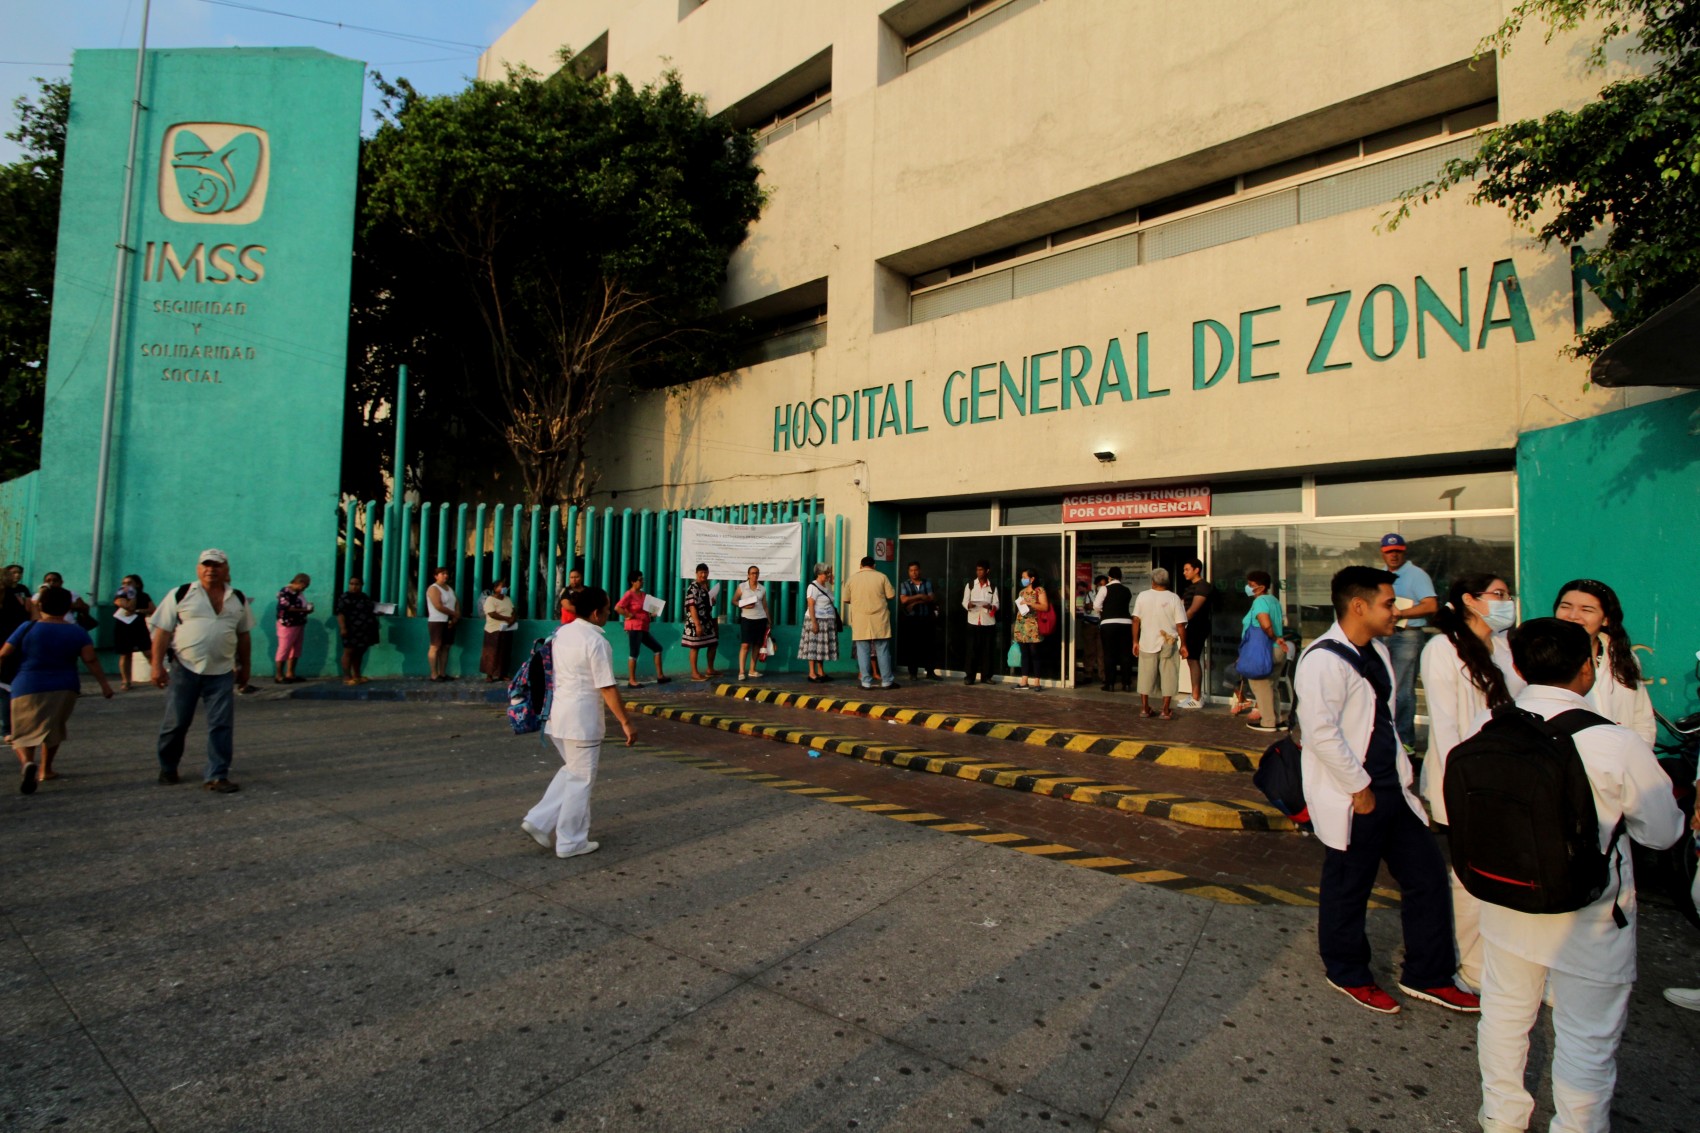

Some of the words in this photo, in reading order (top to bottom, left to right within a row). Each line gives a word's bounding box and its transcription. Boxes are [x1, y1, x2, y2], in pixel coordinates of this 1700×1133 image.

[143, 241, 268, 285] IMSS
[153, 299, 248, 316] SEGURIDAD
[192, 322, 203, 336] Y
[141, 343, 256, 360] SOLIDARIDAD
[773, 379, 929, 452] HOSPITAL
[943, 331, 1171, 427] GENERAL
[1192, 305, 1281, 391] DE
[1306, 258, 1536, 375] ZONA
[161, 367, 223, 384] SOCIAL
[1063, 493, 1112, 506] ACCESO
[1116, 486, 1211, 503] RESTRINGIDO
[1069, 506, 1095, 518] POR
[1098, 500, 1203, 517] CONTINGENCIA
